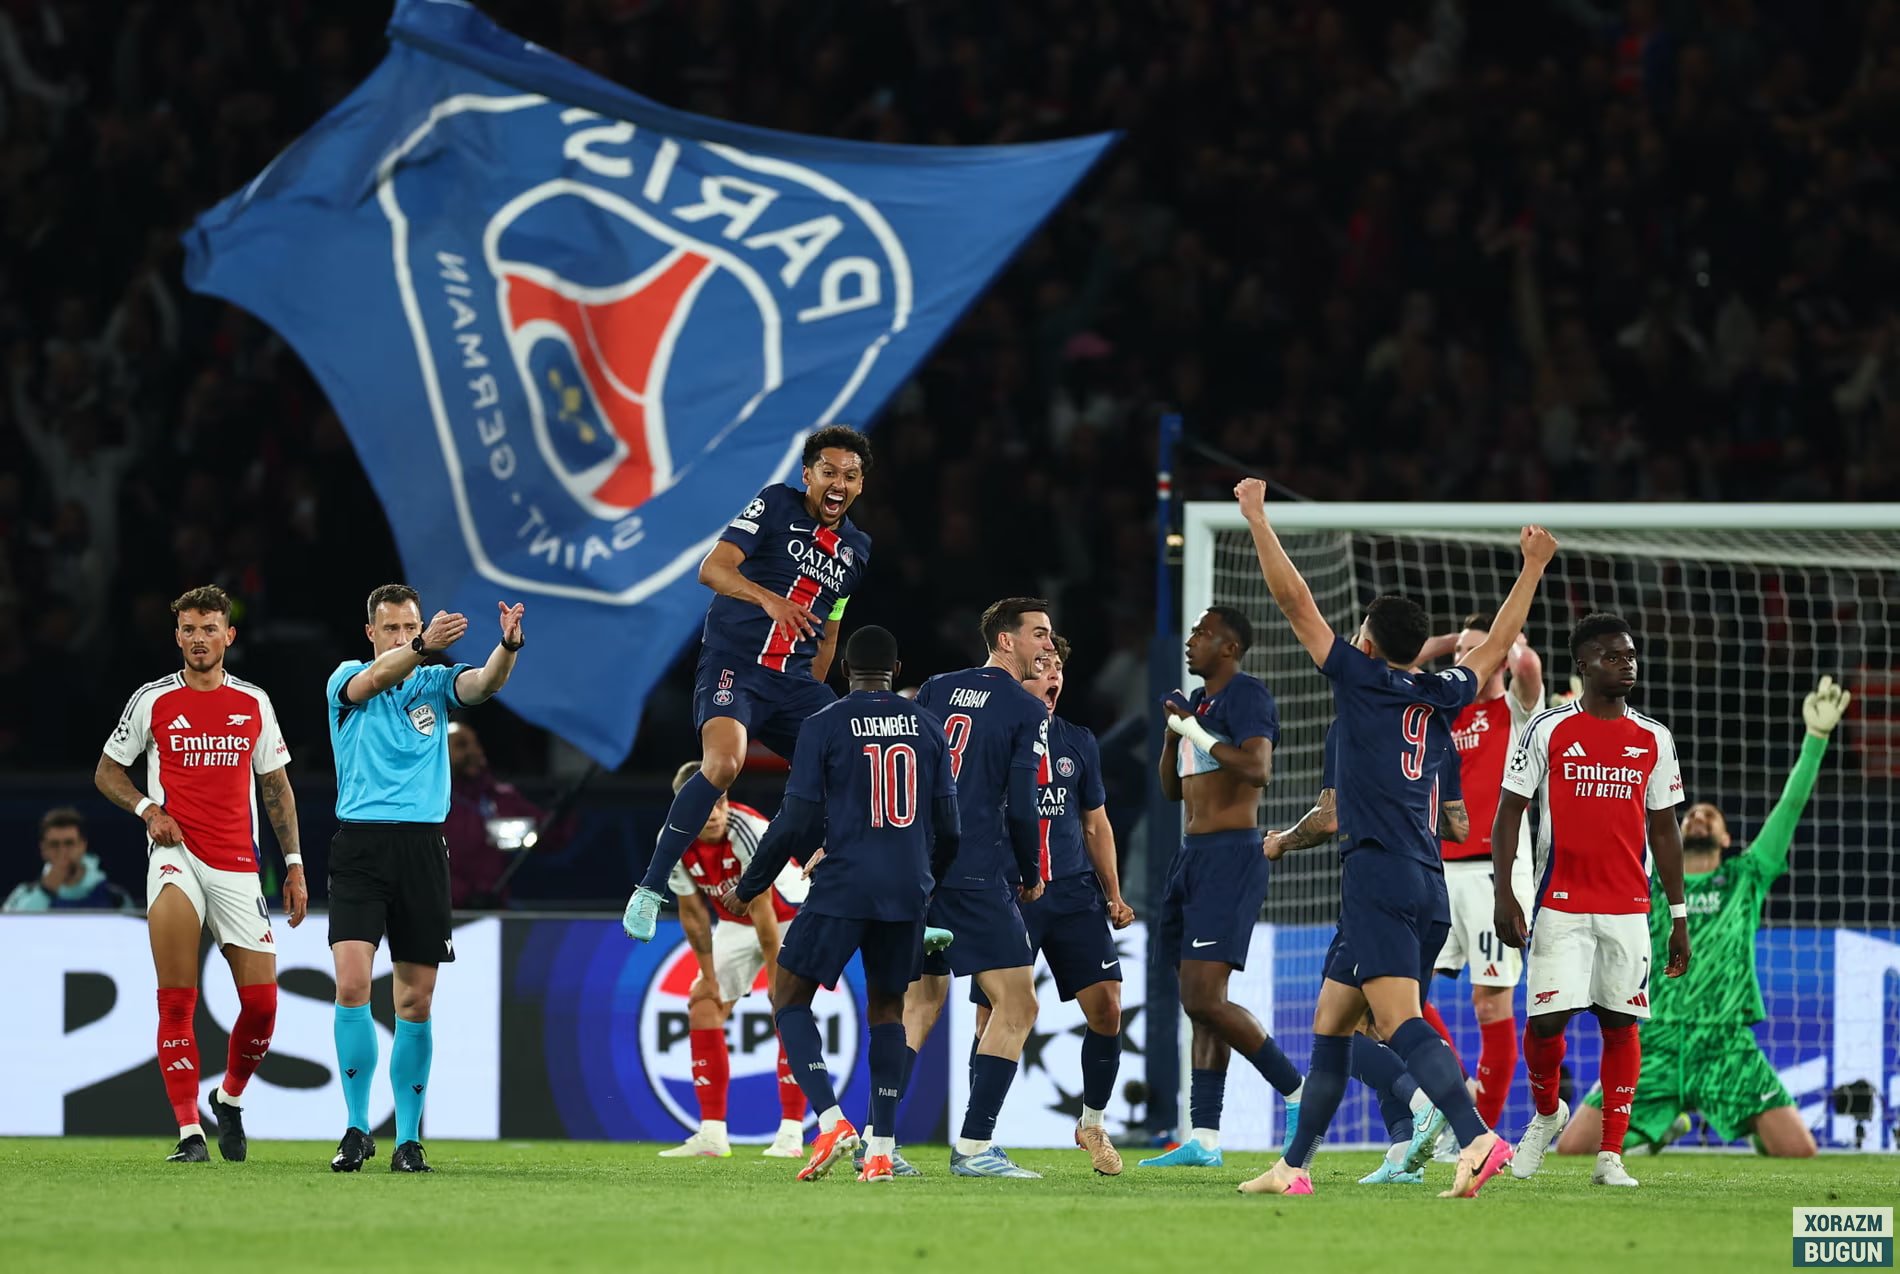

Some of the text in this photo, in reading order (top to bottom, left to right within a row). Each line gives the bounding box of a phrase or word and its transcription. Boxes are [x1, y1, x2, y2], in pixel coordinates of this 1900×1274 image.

[797, 561, 842, 592] AIRWAYS
[718, 668, 735, 690] 5
[949, 687, 991, 708] FABIAN
[170, 732, 250, 752] Emirates
[1401, 702, 1435, 781] 9
[183, 752, 239, 767] FLY BETTER
[1562, 761, 1643, 785] Emirates
[862, 742, 918, 829] 10
[1575, 781, 1632, 799] FLY BETTER
[1479, 931, 1503, 962] 41
[162, 1038, 190, 1048] AFC
[657, 1011, 841, 1055] PPI
[878, 1087, 898, 1098] PARIS
[1616, 1085, 1636, 1095] AFC
